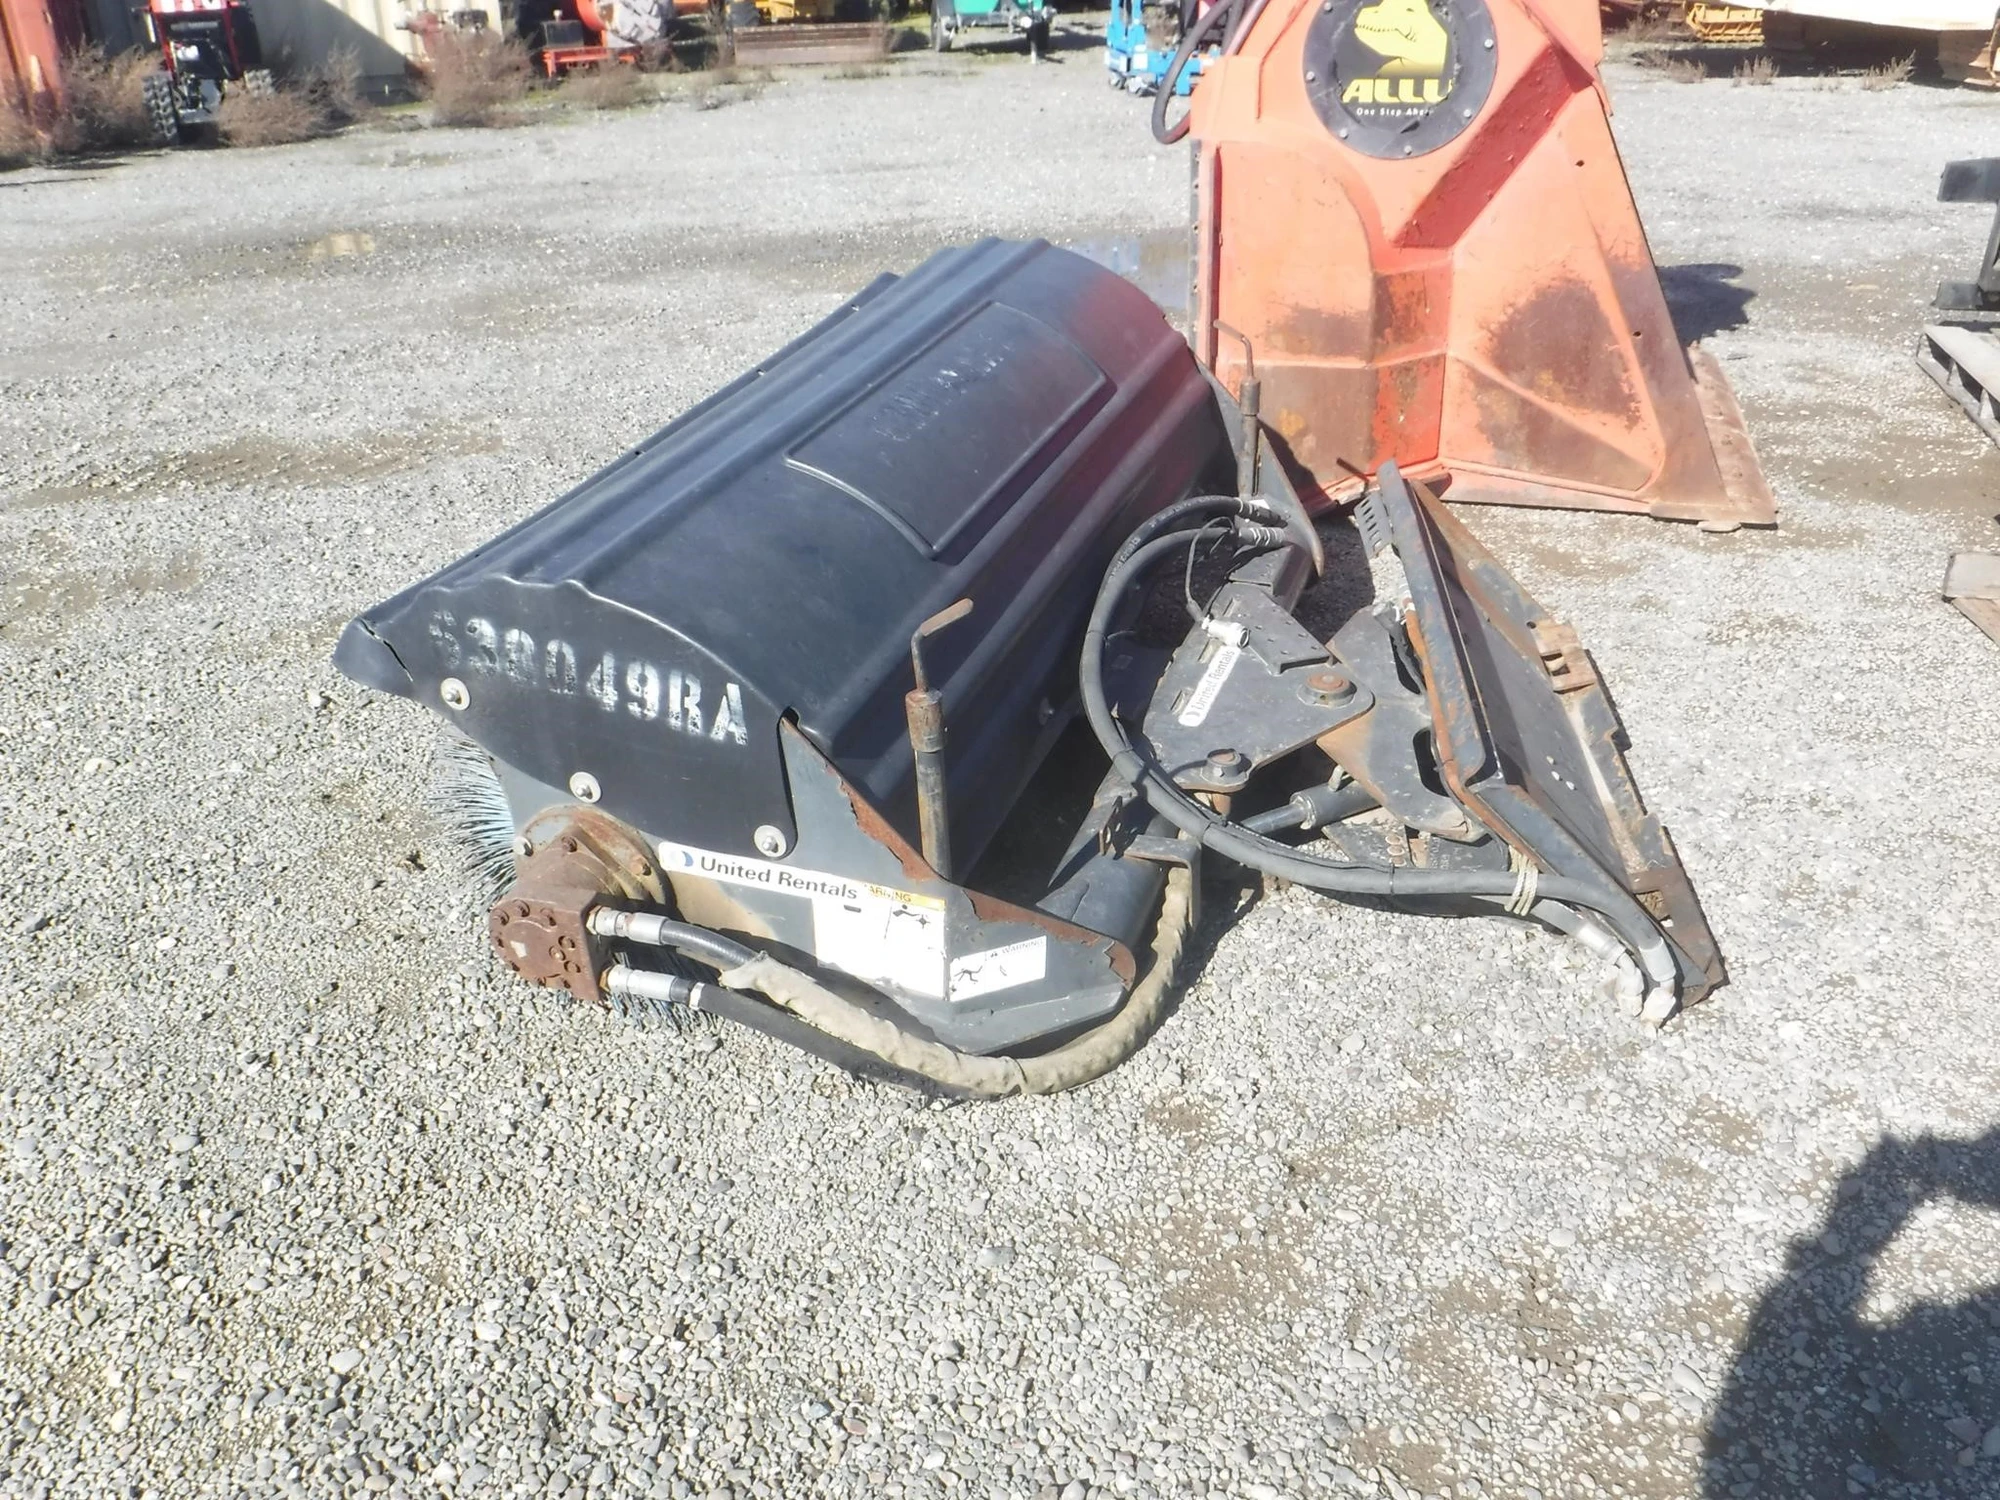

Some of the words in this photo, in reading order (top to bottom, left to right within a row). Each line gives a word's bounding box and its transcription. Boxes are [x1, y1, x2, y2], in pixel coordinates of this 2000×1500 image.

[1356, 107, 1376, 116] One
[1380, 107, 1402, 117] Step
[1191, 679, 1218, 711] United
[1209, 649, 1235, 680] Rentals
[700, 855, 770, 884] United
[778, 872, 858, 900] Rentals
